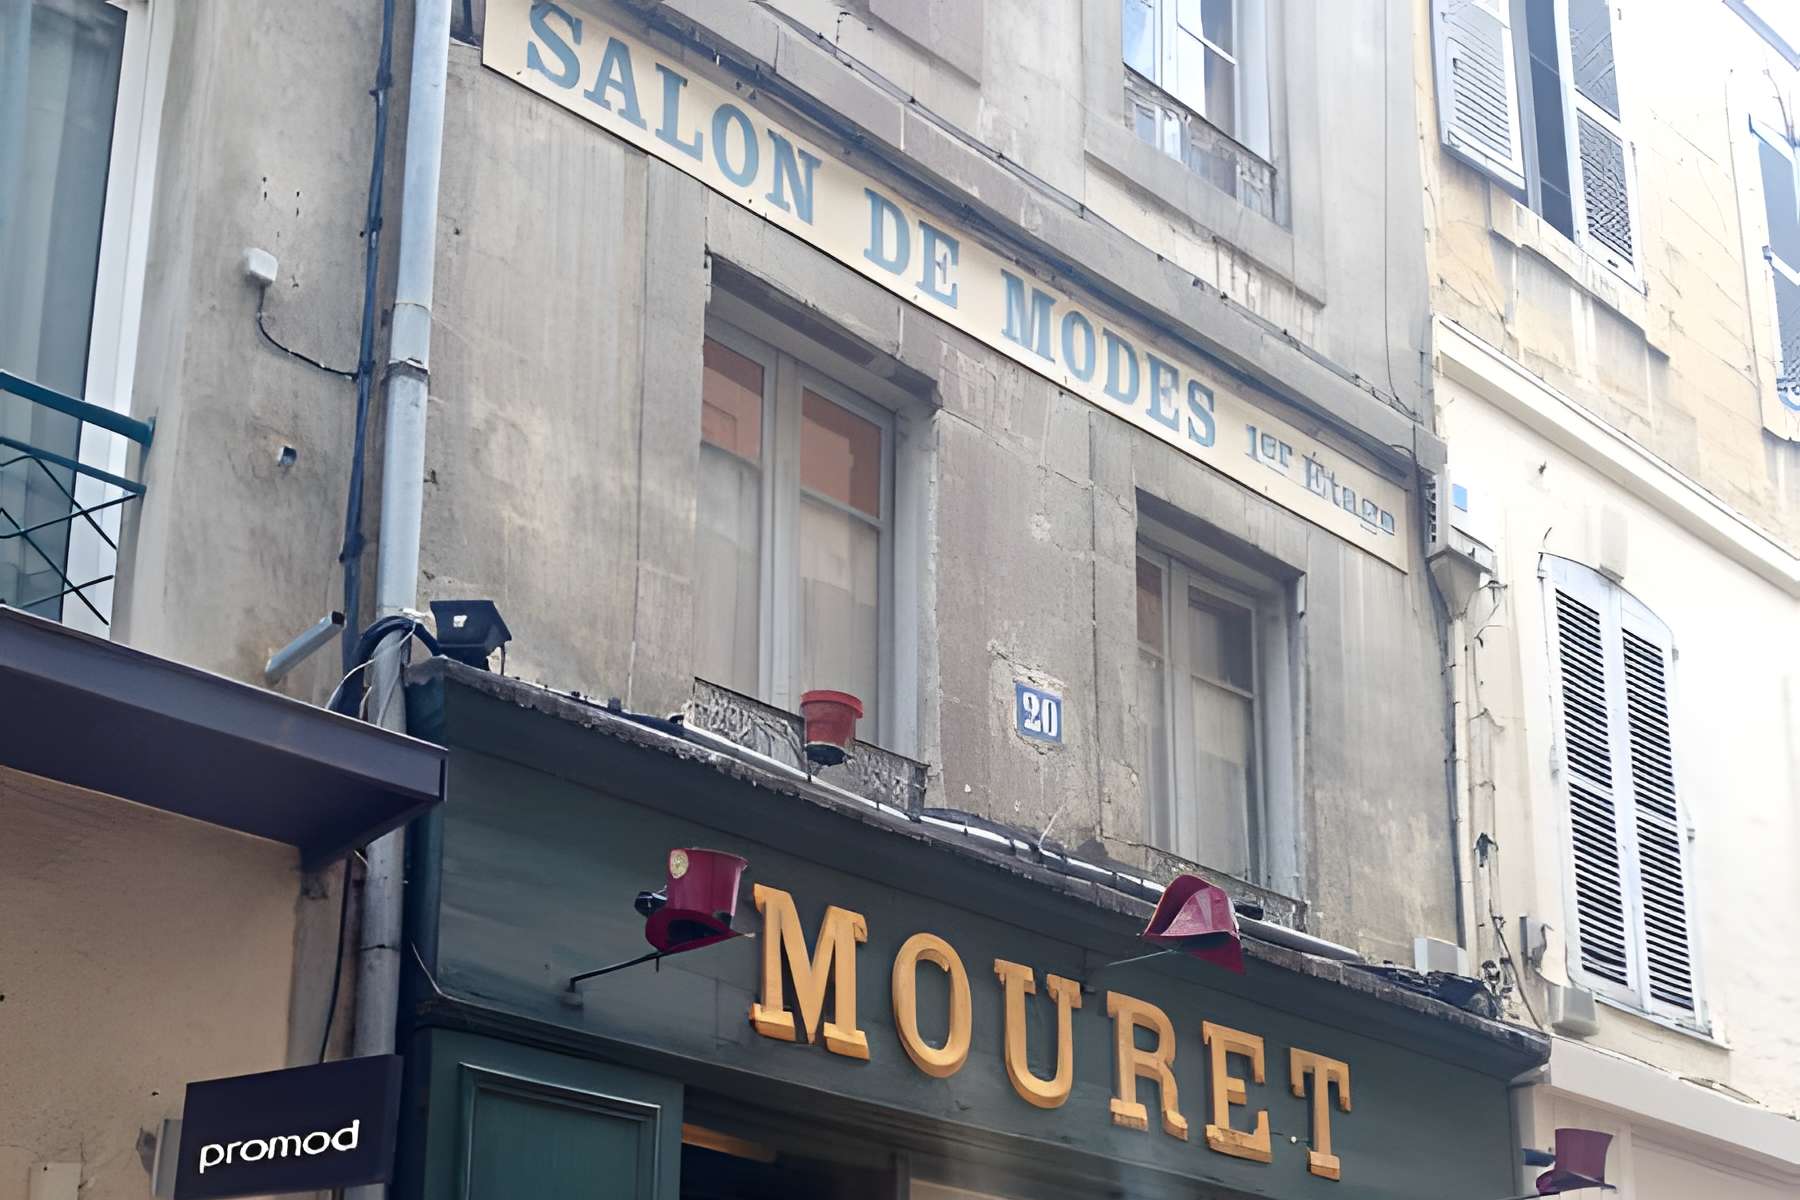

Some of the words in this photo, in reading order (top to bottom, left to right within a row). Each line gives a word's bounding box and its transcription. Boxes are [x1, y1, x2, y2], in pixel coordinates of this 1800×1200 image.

[527, 1, 822, 226] SALON
[864, 187, 960, 310] DE
[1001, 268, 1215, 448] MODES
[1022, 691, 1058, 737] 20
[749, 882, 1352, 1181] MOURET
[199, 1119, 360, 1174] promod
